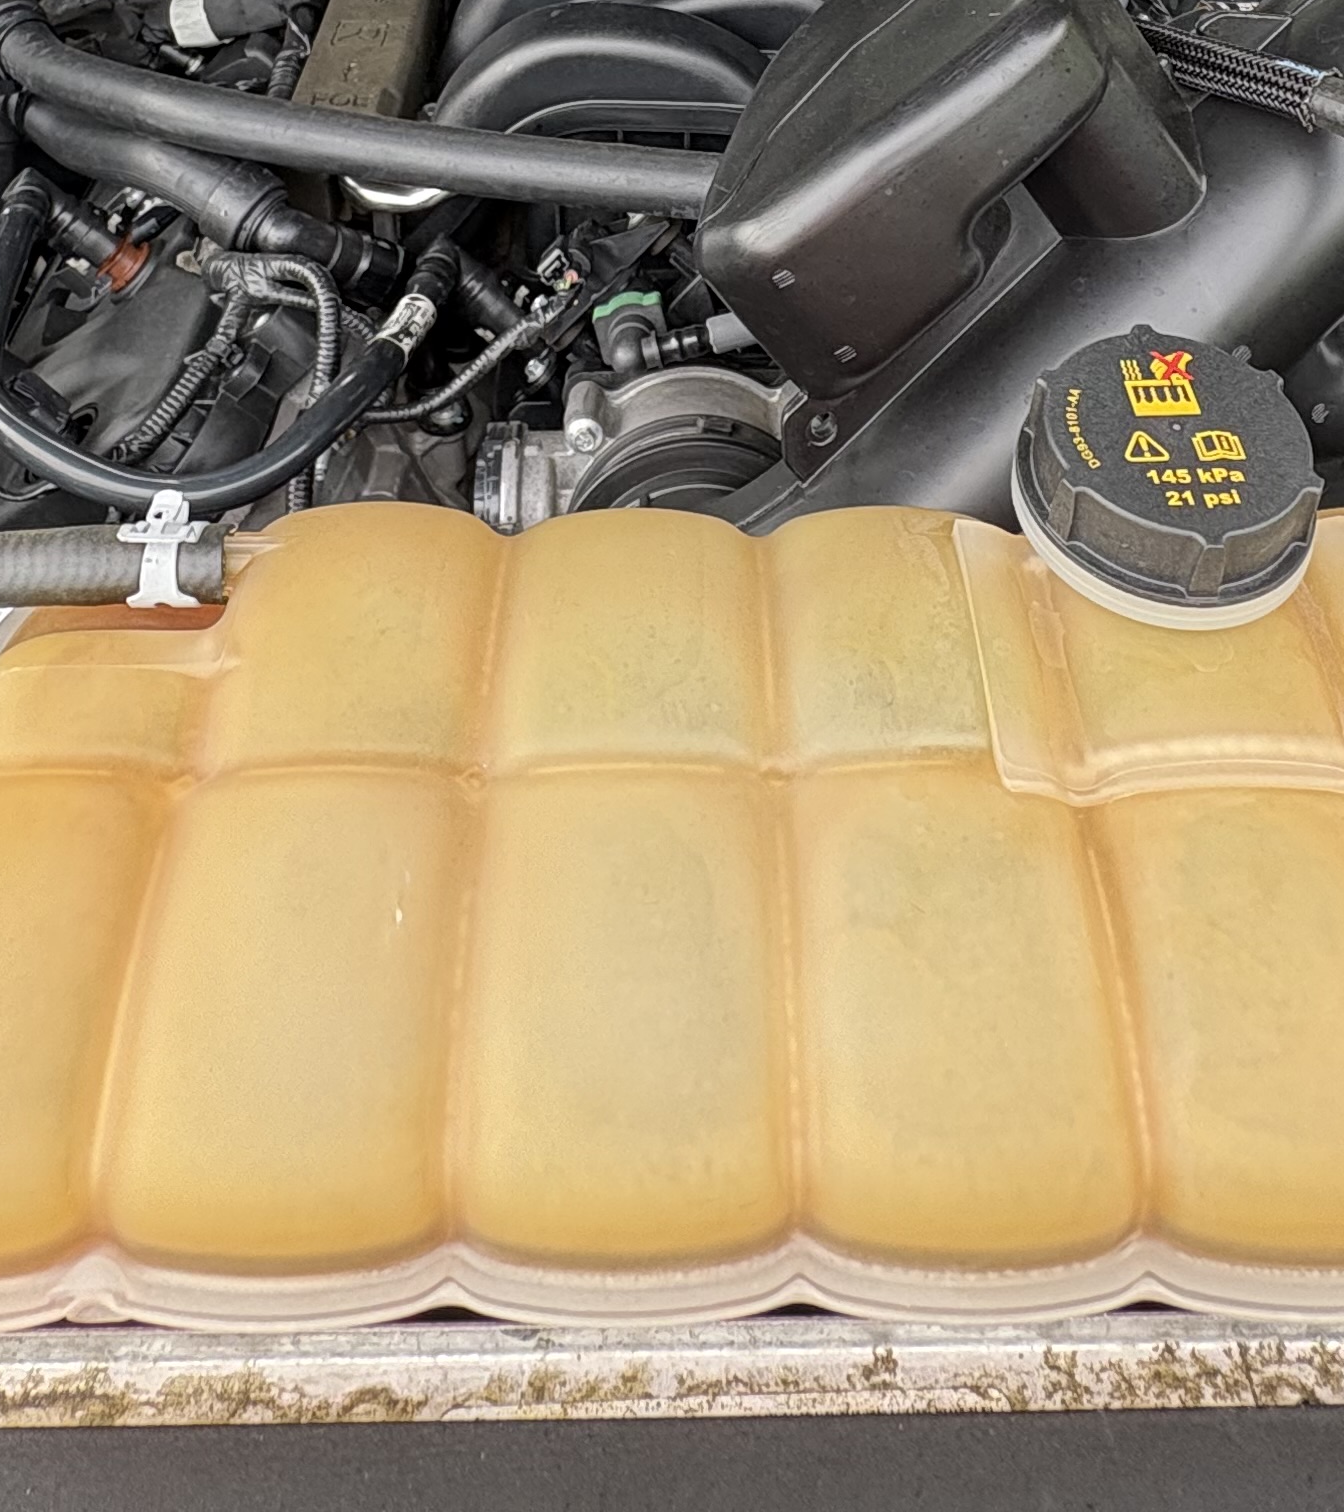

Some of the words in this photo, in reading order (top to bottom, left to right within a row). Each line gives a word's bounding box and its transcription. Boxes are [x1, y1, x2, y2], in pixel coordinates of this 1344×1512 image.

[1146, 468, 1192, 485] 145
[1196, 467, 1246, 484] kPa
[1165, 489, 1195, 506] 21
[1203, 488, 1241, 509] psi
